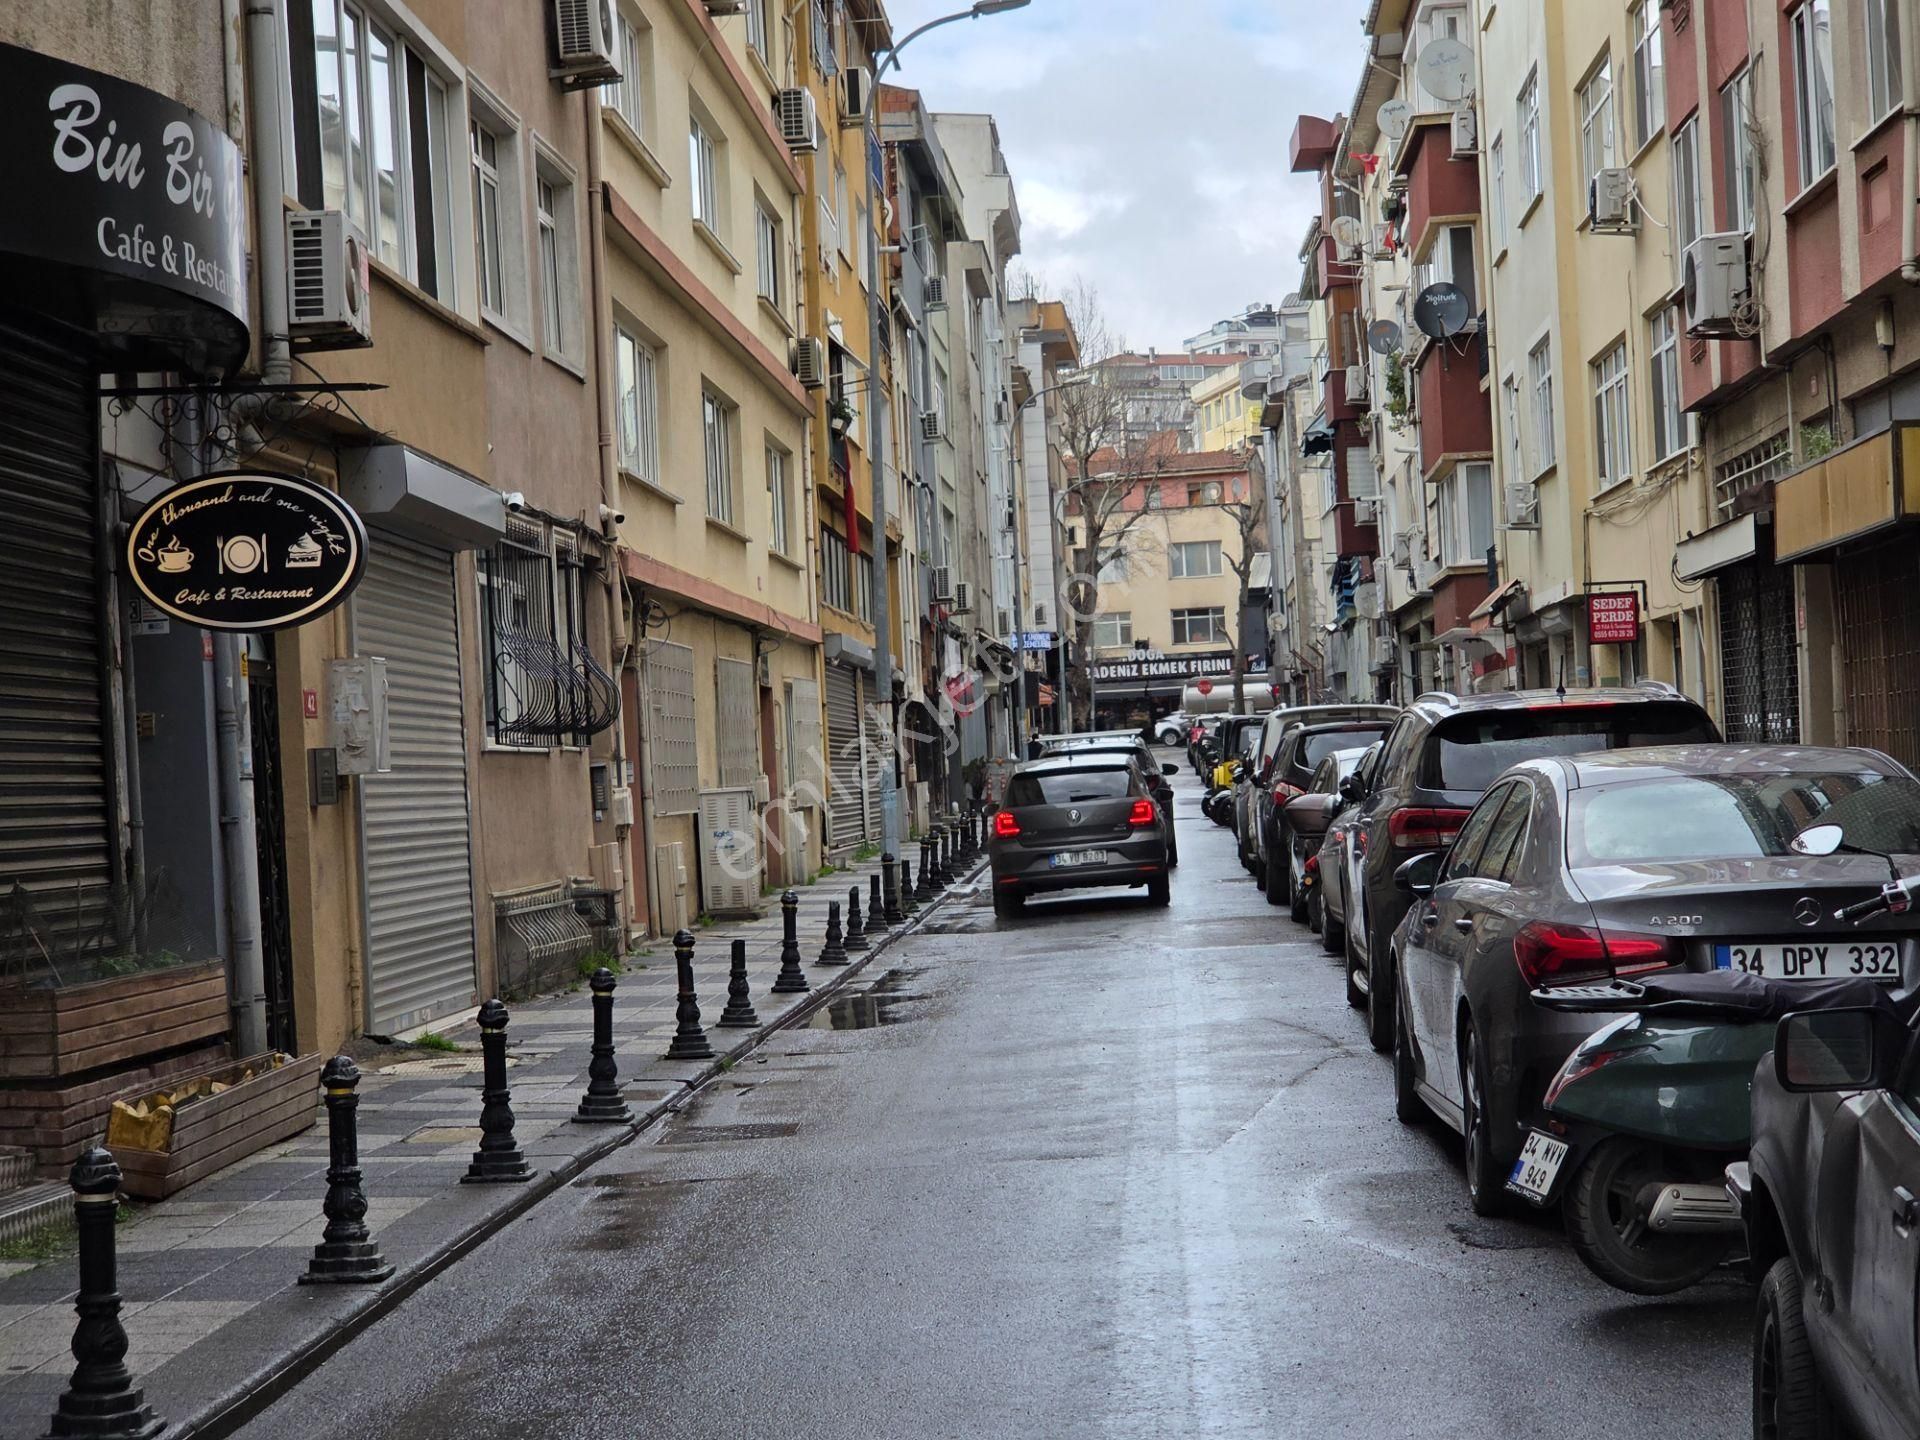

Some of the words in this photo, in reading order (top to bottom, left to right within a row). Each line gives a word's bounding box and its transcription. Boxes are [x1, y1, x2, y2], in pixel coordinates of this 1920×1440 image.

[49, 84, 145, 189] Bin
[163, 121, 215, 218] Bir
[97, 217, 156, 267] Cafe
[161, 235, 179, 275] &
[137, 527, 159, 561] One
[162, 485, 233, 525] thousand
[239, 487, 273, 503] and
[276, 499, 304, 512] one
[309, 514, 346, 556] night
[175, 588, 210, 605] Cafe
[215, 587, 226, 601] &
[231, 586, 313, 601] Restaurant
[1593, 598, 1632, 610] SEDEF
[1592, 611, 1634, 623] PERDE
[1142, 661, 1187, 675] EKMEK
[1190, 658, 1231, 673] FIRINI
[307, 695, 316, 712] 42
[1650, 916, 1662, 925] A
[1667, 915, 1703, 925] 200
[1732, 948, 1764, 975] 34
[1783, 947, 1829, 975] DPY
[1848, 946, 1897, 974] 332
[1525, 1135, 1541, 1157] 34
[1525, 1165, 1547, 1189] 949
